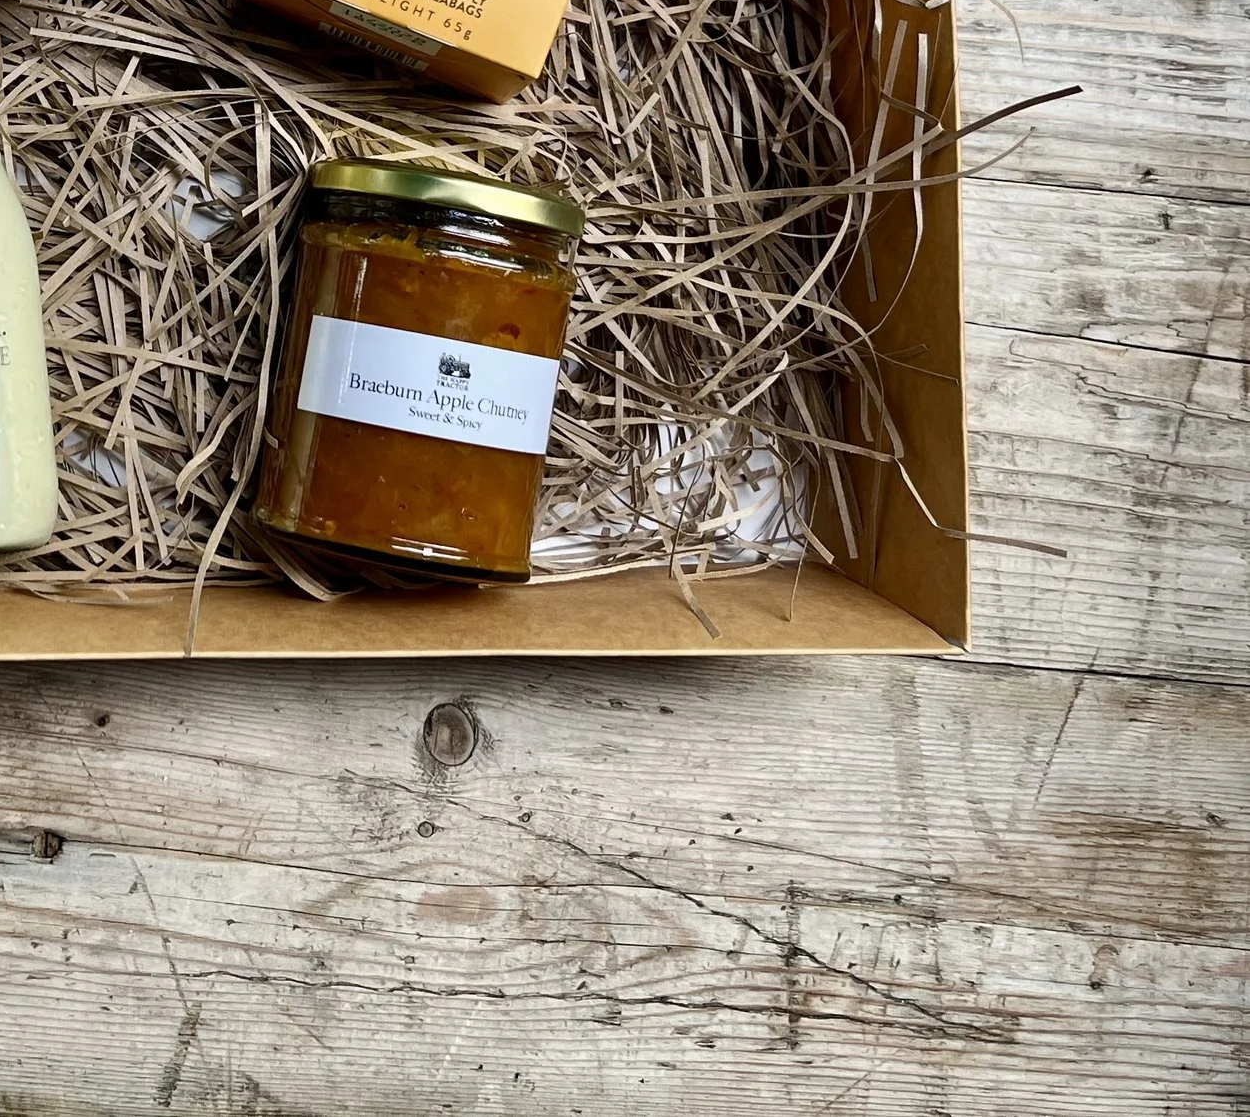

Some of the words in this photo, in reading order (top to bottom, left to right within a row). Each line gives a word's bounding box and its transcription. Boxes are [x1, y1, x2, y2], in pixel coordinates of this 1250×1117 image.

[349, 372, 423, 402] Braeburn
[427, 389, 474, 412] Apple
[478, 398, 530, 425] Chutney
[408, 406, 440, 423] Sweet
[442, 413, 454, 424] &
[456, 415, 483, 431] Spicy
